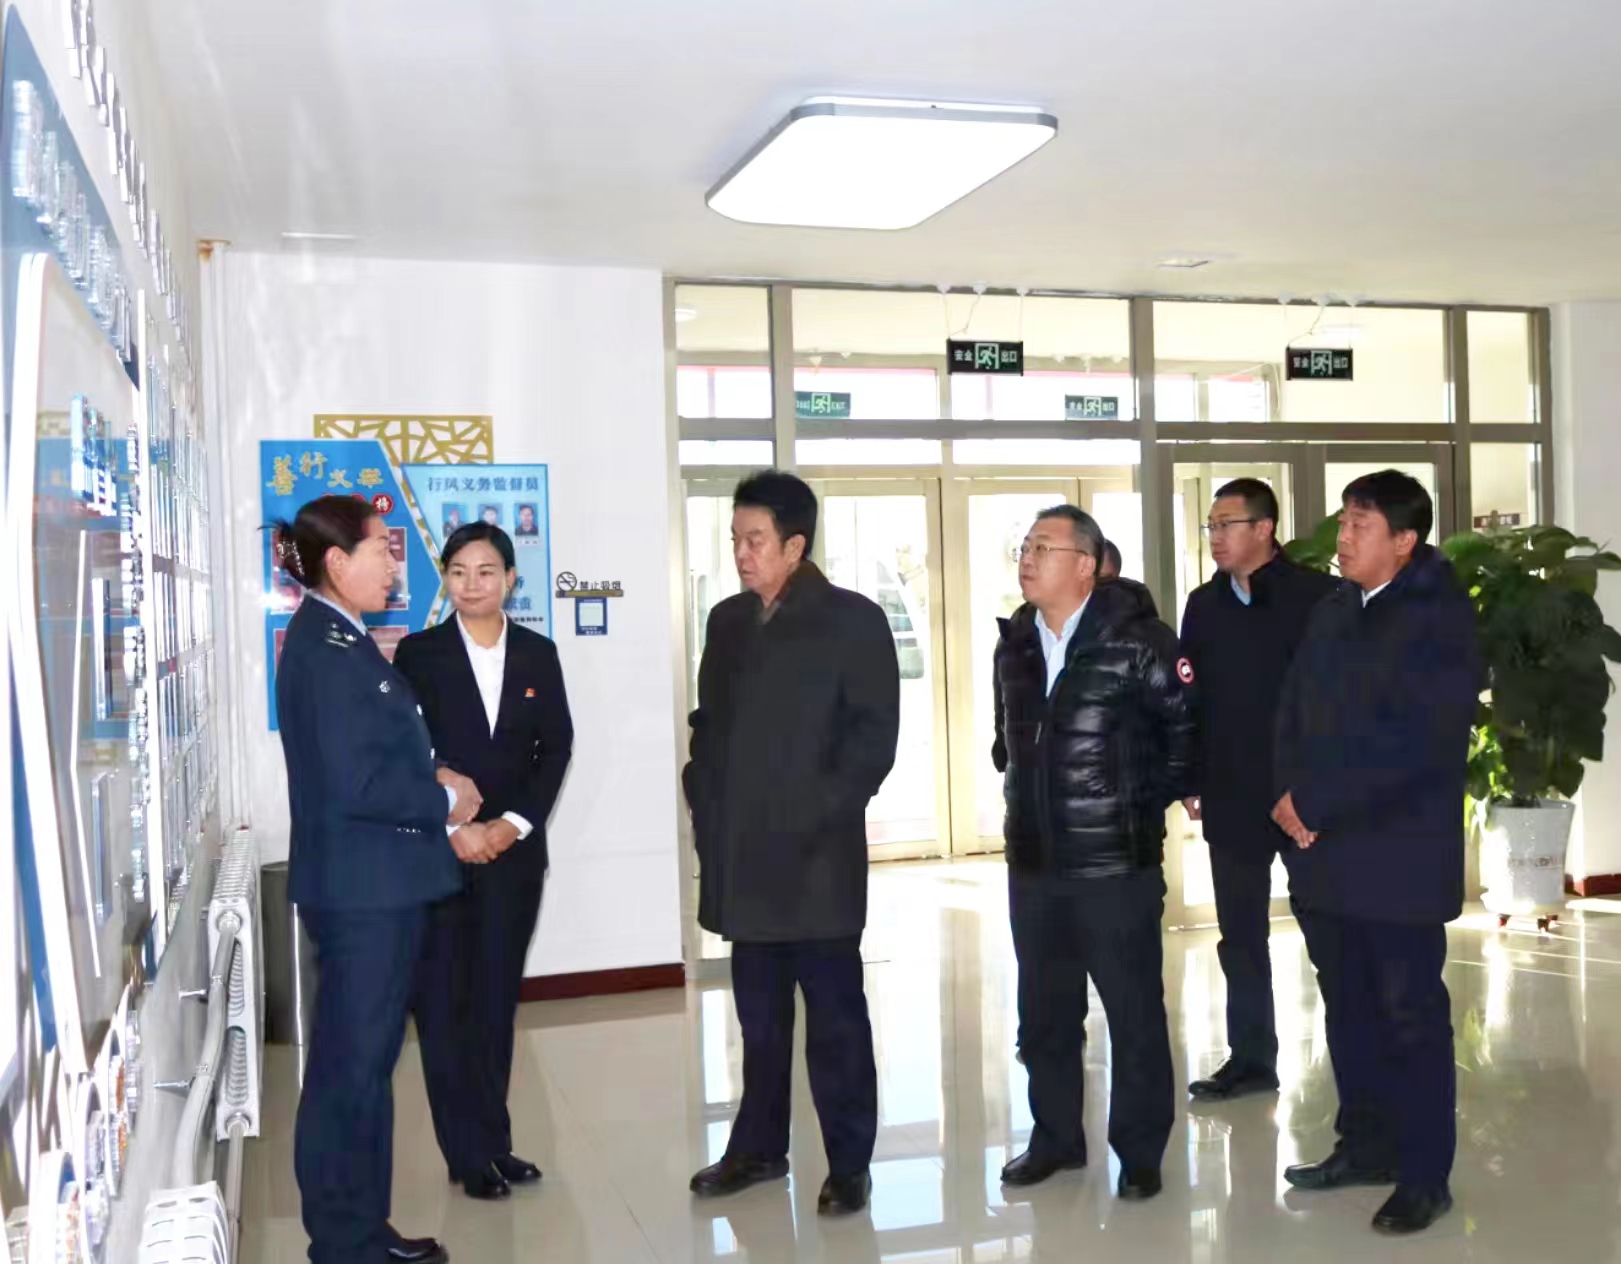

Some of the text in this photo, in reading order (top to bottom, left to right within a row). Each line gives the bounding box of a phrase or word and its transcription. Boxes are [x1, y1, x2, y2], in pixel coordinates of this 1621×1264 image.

[954, 349, 1017, 363] 安全 出口
[1333, 357, 1348, 368] 出口
[428, 476, 539, 492] 行风义务监督员
[579, 580, 622, 591] 禁止吸烟
